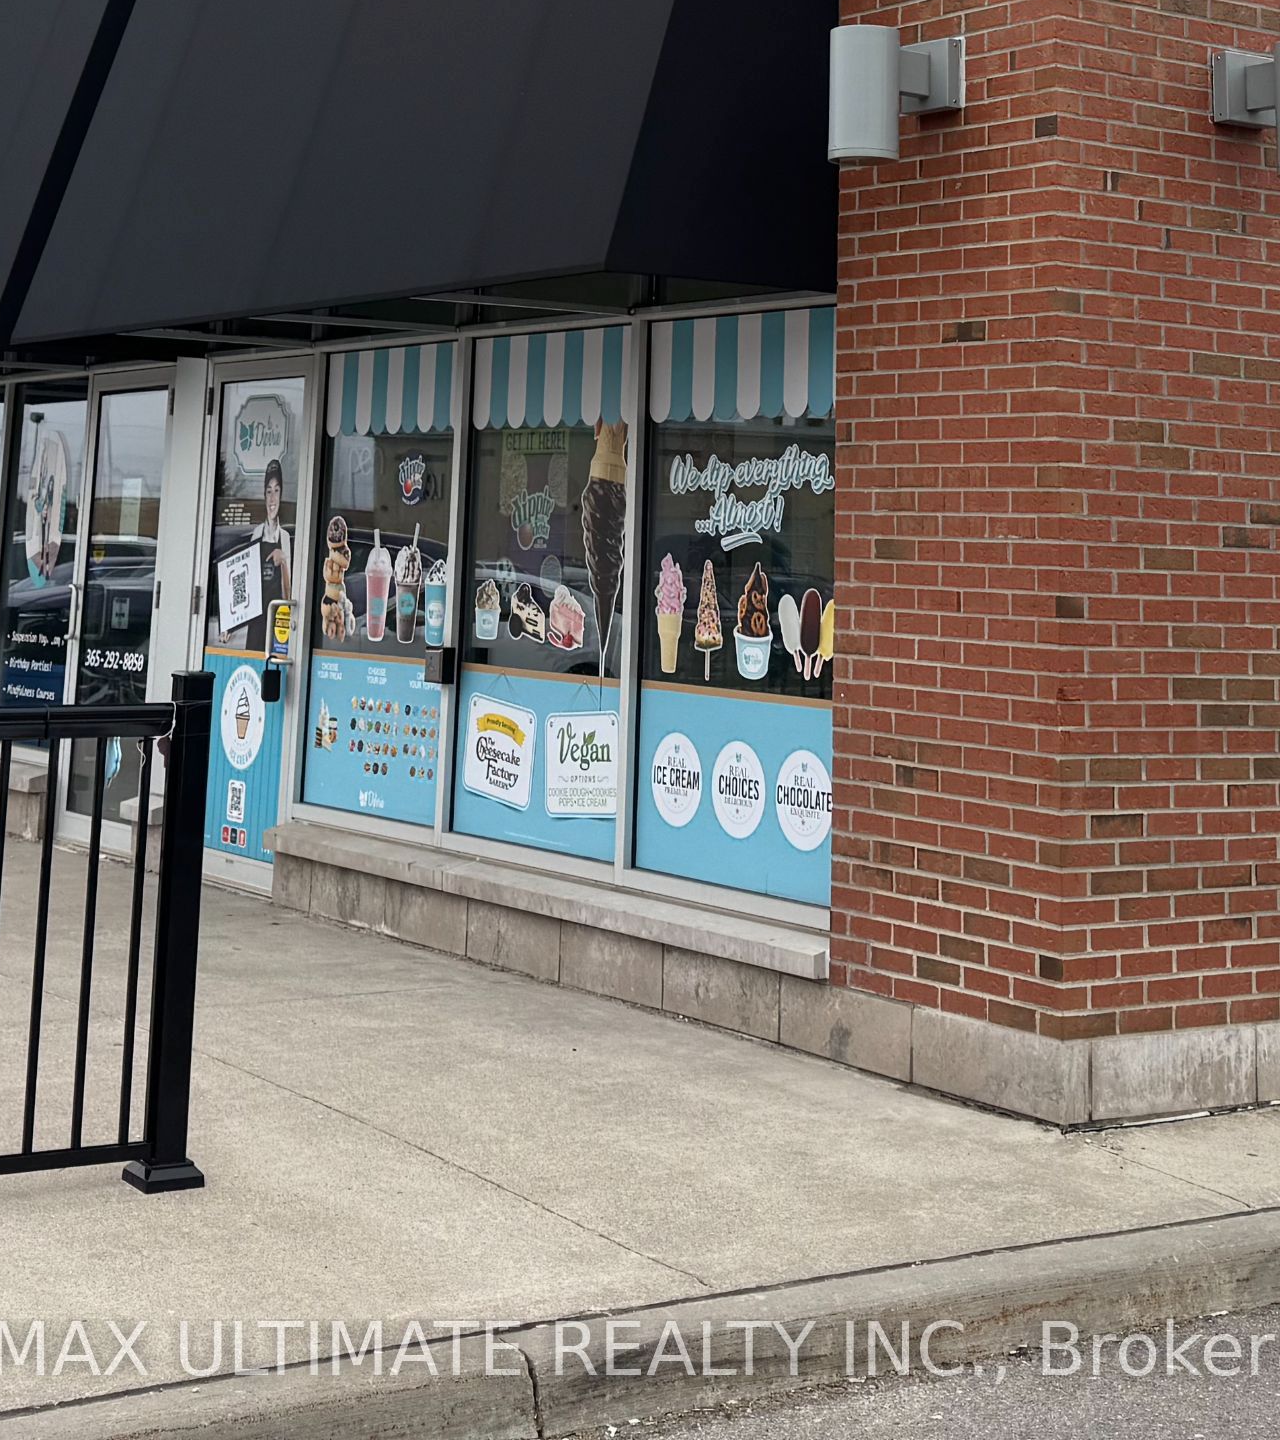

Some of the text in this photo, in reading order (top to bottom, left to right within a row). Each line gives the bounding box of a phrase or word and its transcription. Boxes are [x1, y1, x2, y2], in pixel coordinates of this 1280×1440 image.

[505, 430, 567, 451] GET IT HERE!
[670, 443, 836, 501] We dip everything
[9, 656, 53, 673] Birthday Parties!
[84, 648, 145, 672] 365-292-8050
[6, 683, 55, 701] Mindfulness Courses
[476, 736, 521, 766] Cheesecake
[557, 722, 612, 771] Vegan
[667, 755, 687, 769] REAL
[729, 764, 750, 778] REAL
[485, 756, 519, 788] Factory
[570, 775, 596, 783] OPTIONS
[653, 764, 700, 791] ICE CREAM
[718, 774, 760, 801] CHOICES
[794, 774, 816, 789] REAL
[548, 787, 569, 797] COOKIE
[776, 784, 833, 813] CHOCOLATE
[586, 797, 607, 807] CREAM
[724, 796, 753, 808] DELICIOUS
[790, 806, 821, 820] EXQUISITE
